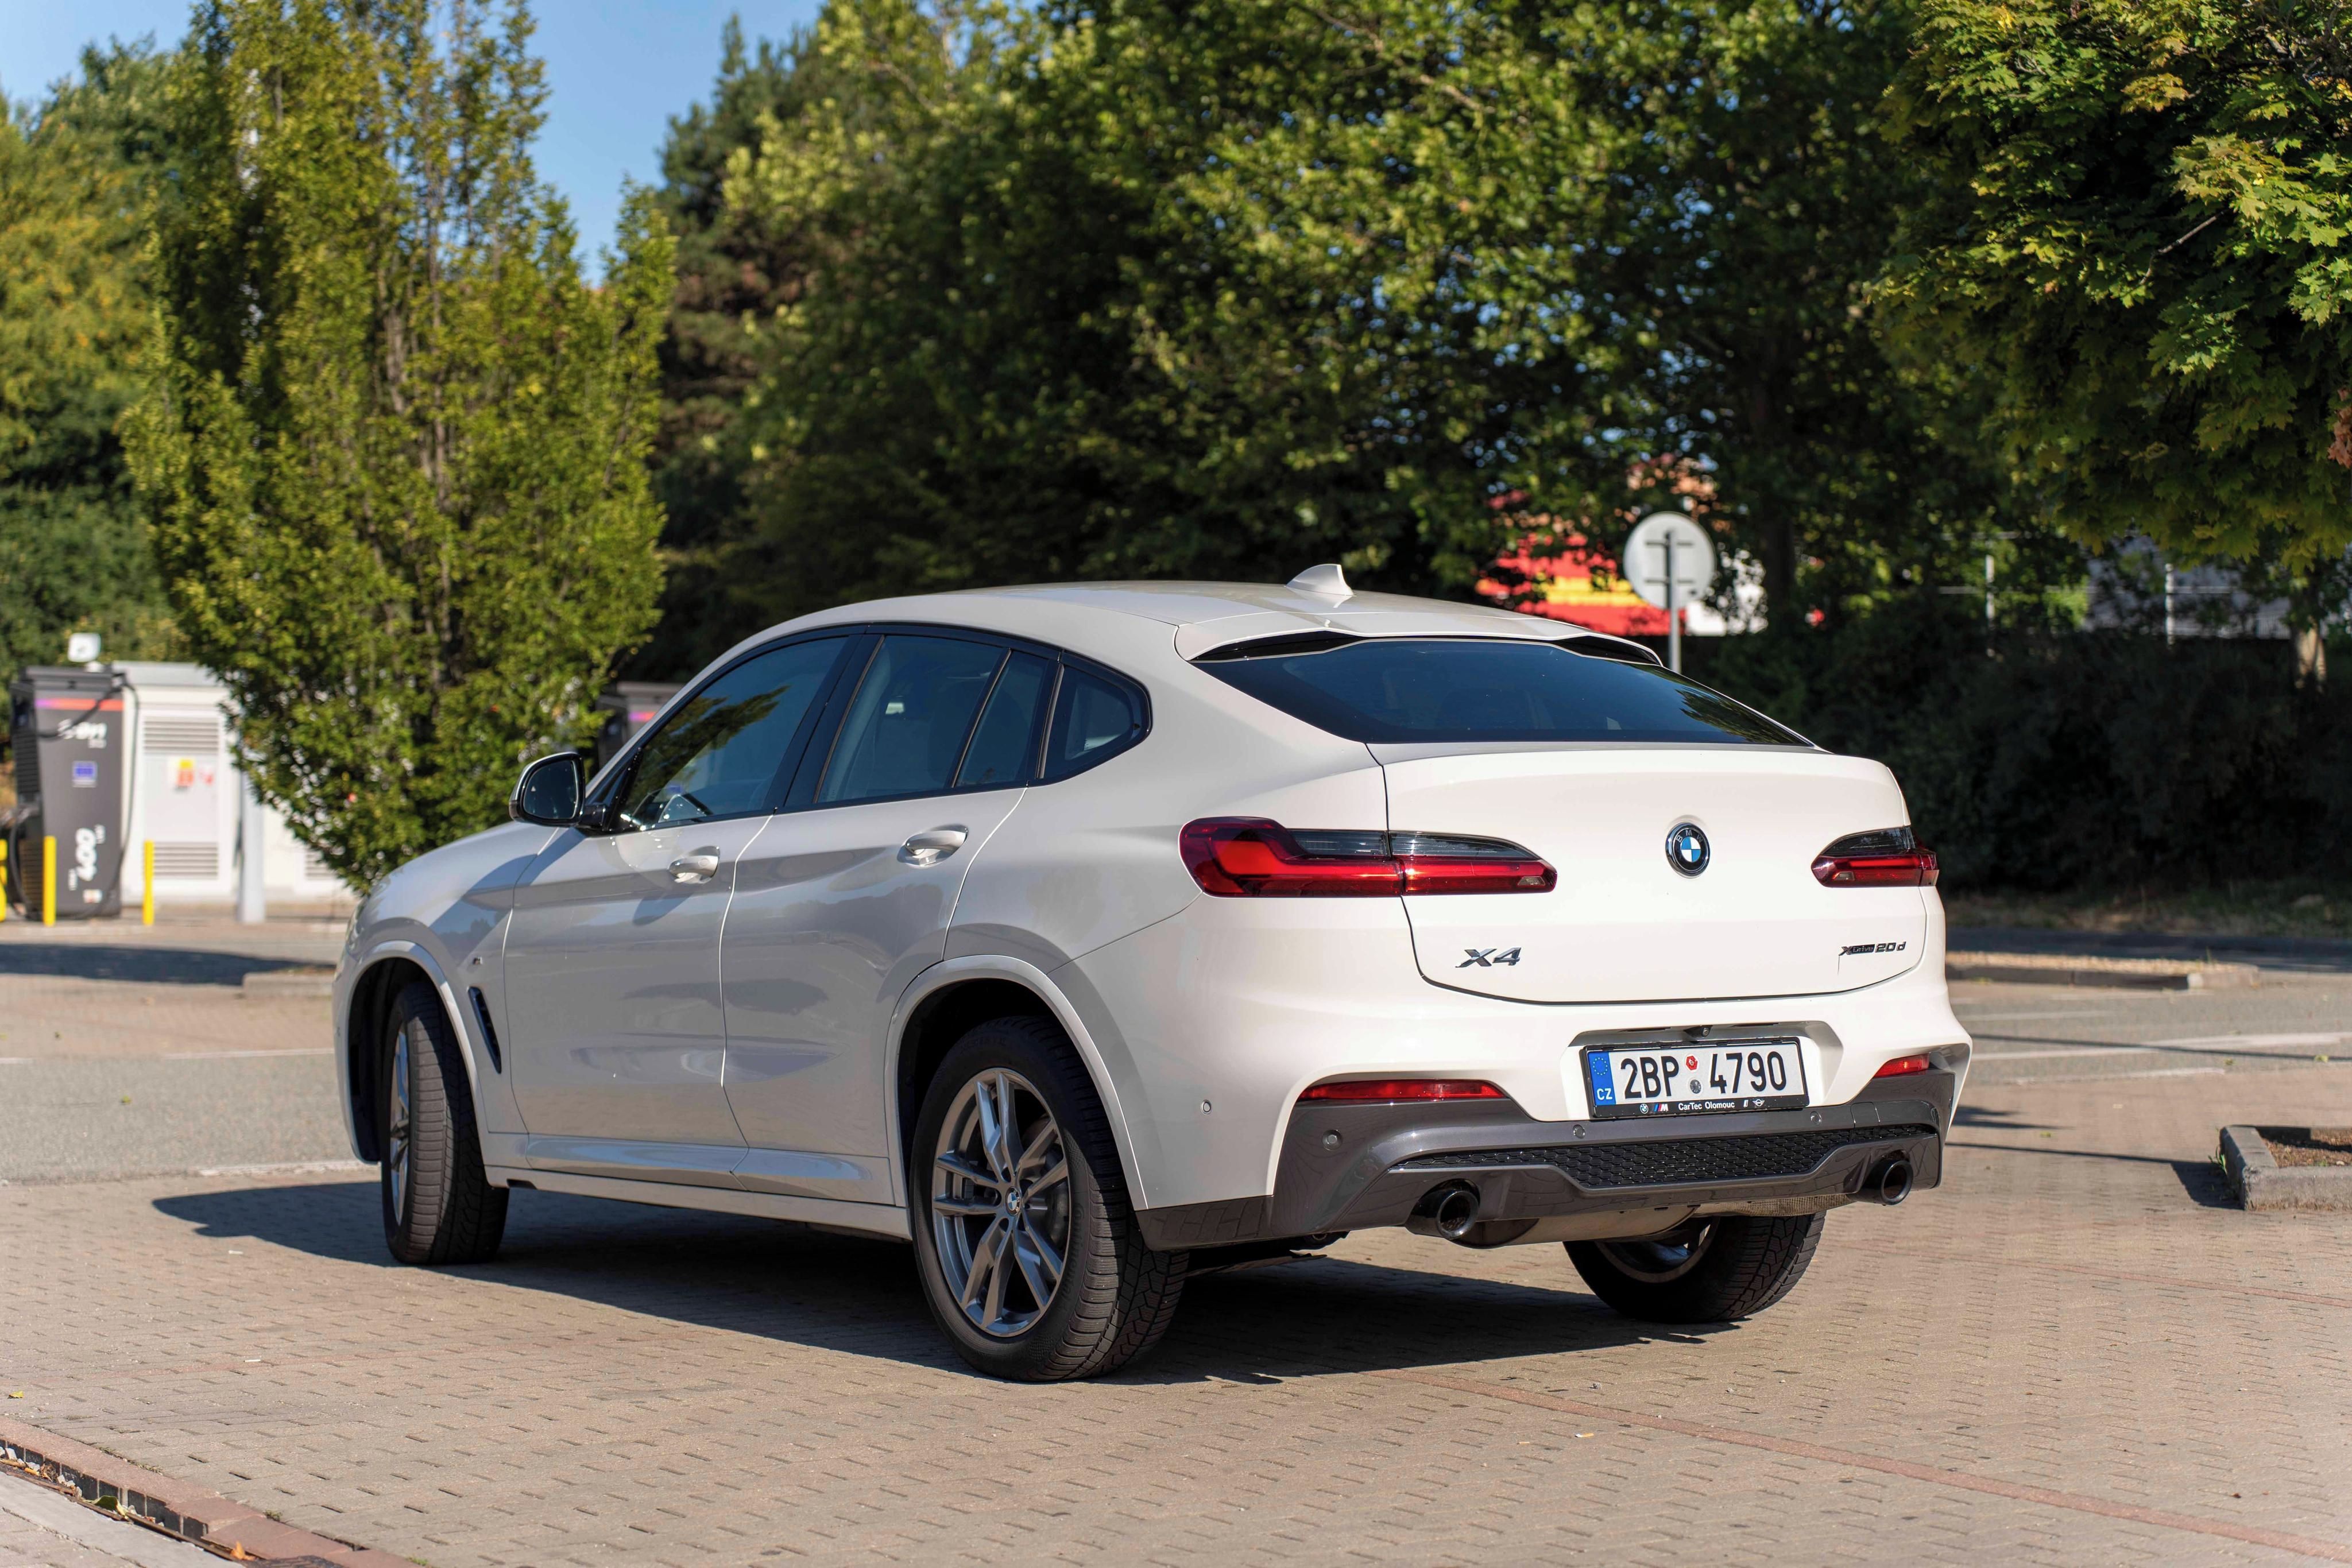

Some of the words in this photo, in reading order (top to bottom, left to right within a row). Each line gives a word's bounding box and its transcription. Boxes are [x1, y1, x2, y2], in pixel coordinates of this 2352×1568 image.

[1676, 830, 1703, 843] BMW
[1455, 947, 1521, 967] X4
[1620, 1056, 1679, 1099] 2BP
[1710, 1051, 1787, 1094] 4790
[1596, 1088, 1613, 1101] CZ
[1678, 1102, 1703, 1110] CarTec
[1705, 1101, 1735, 1109] Olomouc
